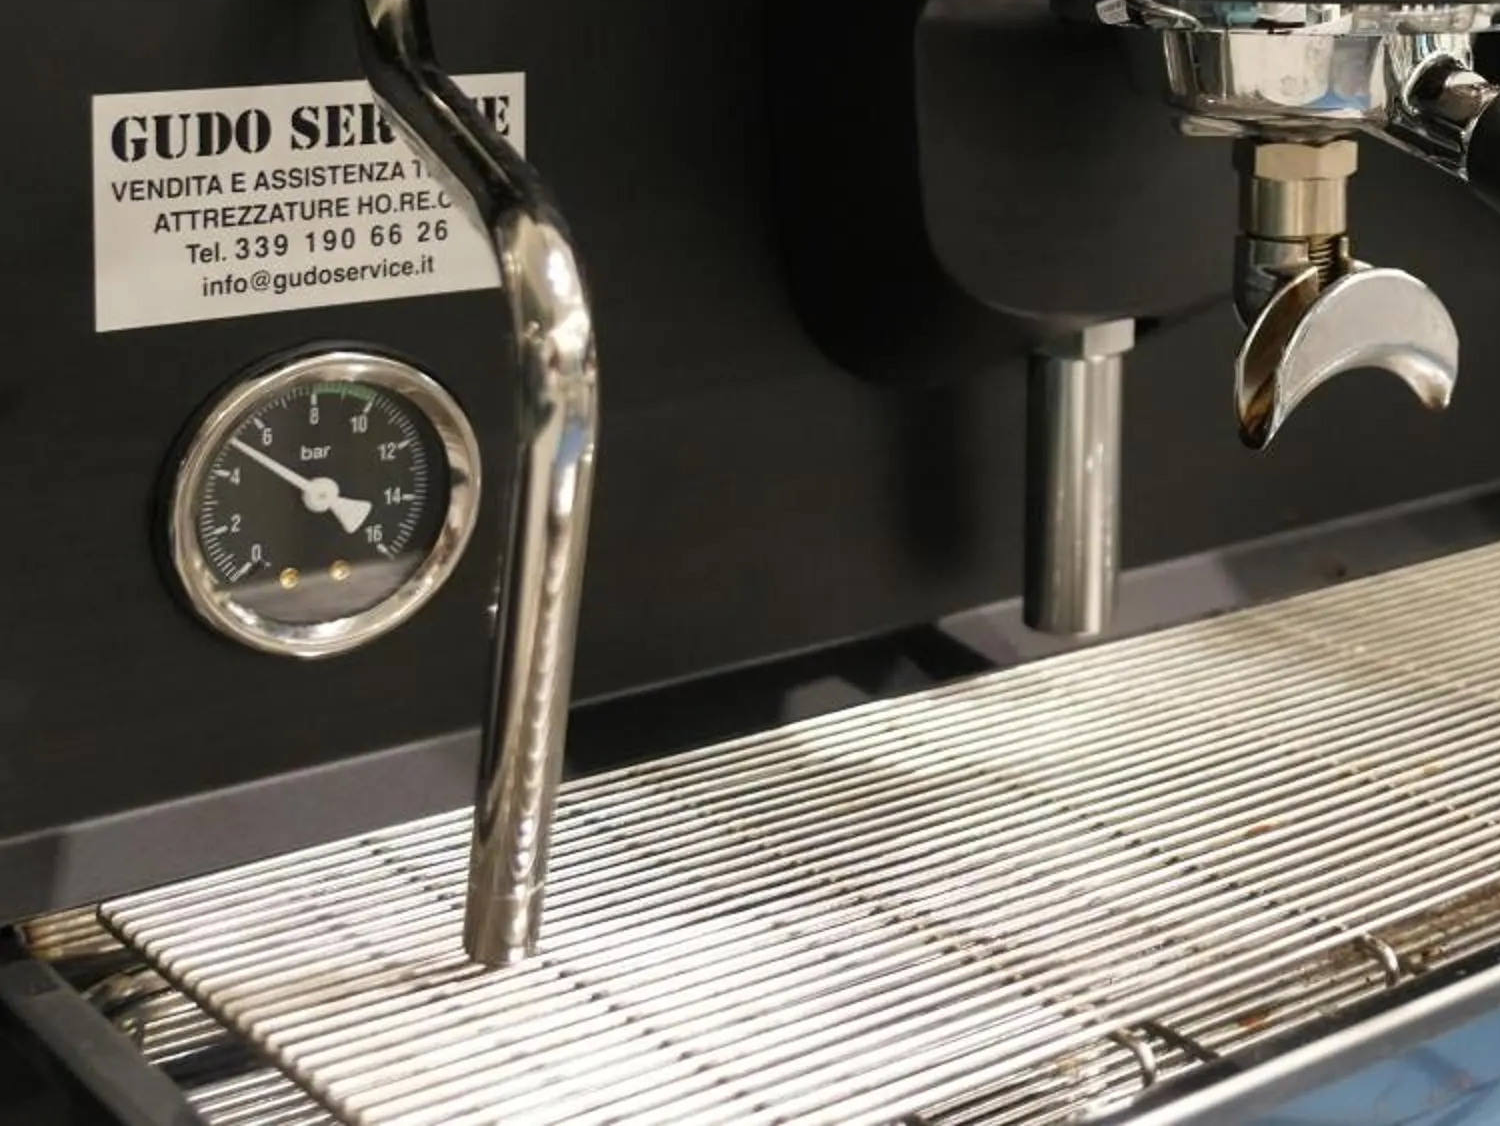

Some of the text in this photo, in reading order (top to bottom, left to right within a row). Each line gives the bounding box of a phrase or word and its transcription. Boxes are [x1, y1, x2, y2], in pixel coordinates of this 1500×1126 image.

[110, 95, 509, 163] GUDO SERE
[112, 175, 223, 202] VENDITA
[231, 172, 246, 193] E
[254, 160, 405, 191] ASSISTENZA
[153, 190, 453, 234] ATTREZZATURE HO.RE.C
[186, 219, 449, 265] Tel. 339 190 66 26
[202, 254, 435, 297] info@gudoservice.it
[309, 407, 320, 425] 8
[351, 414, 368, 433] 10
[262, 427, 273, 446] 6
[300, 444, 331, 461] bar
[379, 443, 397, 461] 12
[229, 469, 241, 486] 4
[385, 487, 401, 506] 14
[230, 514, 241, 534] 2
[366, 524, 383, 543] 16
